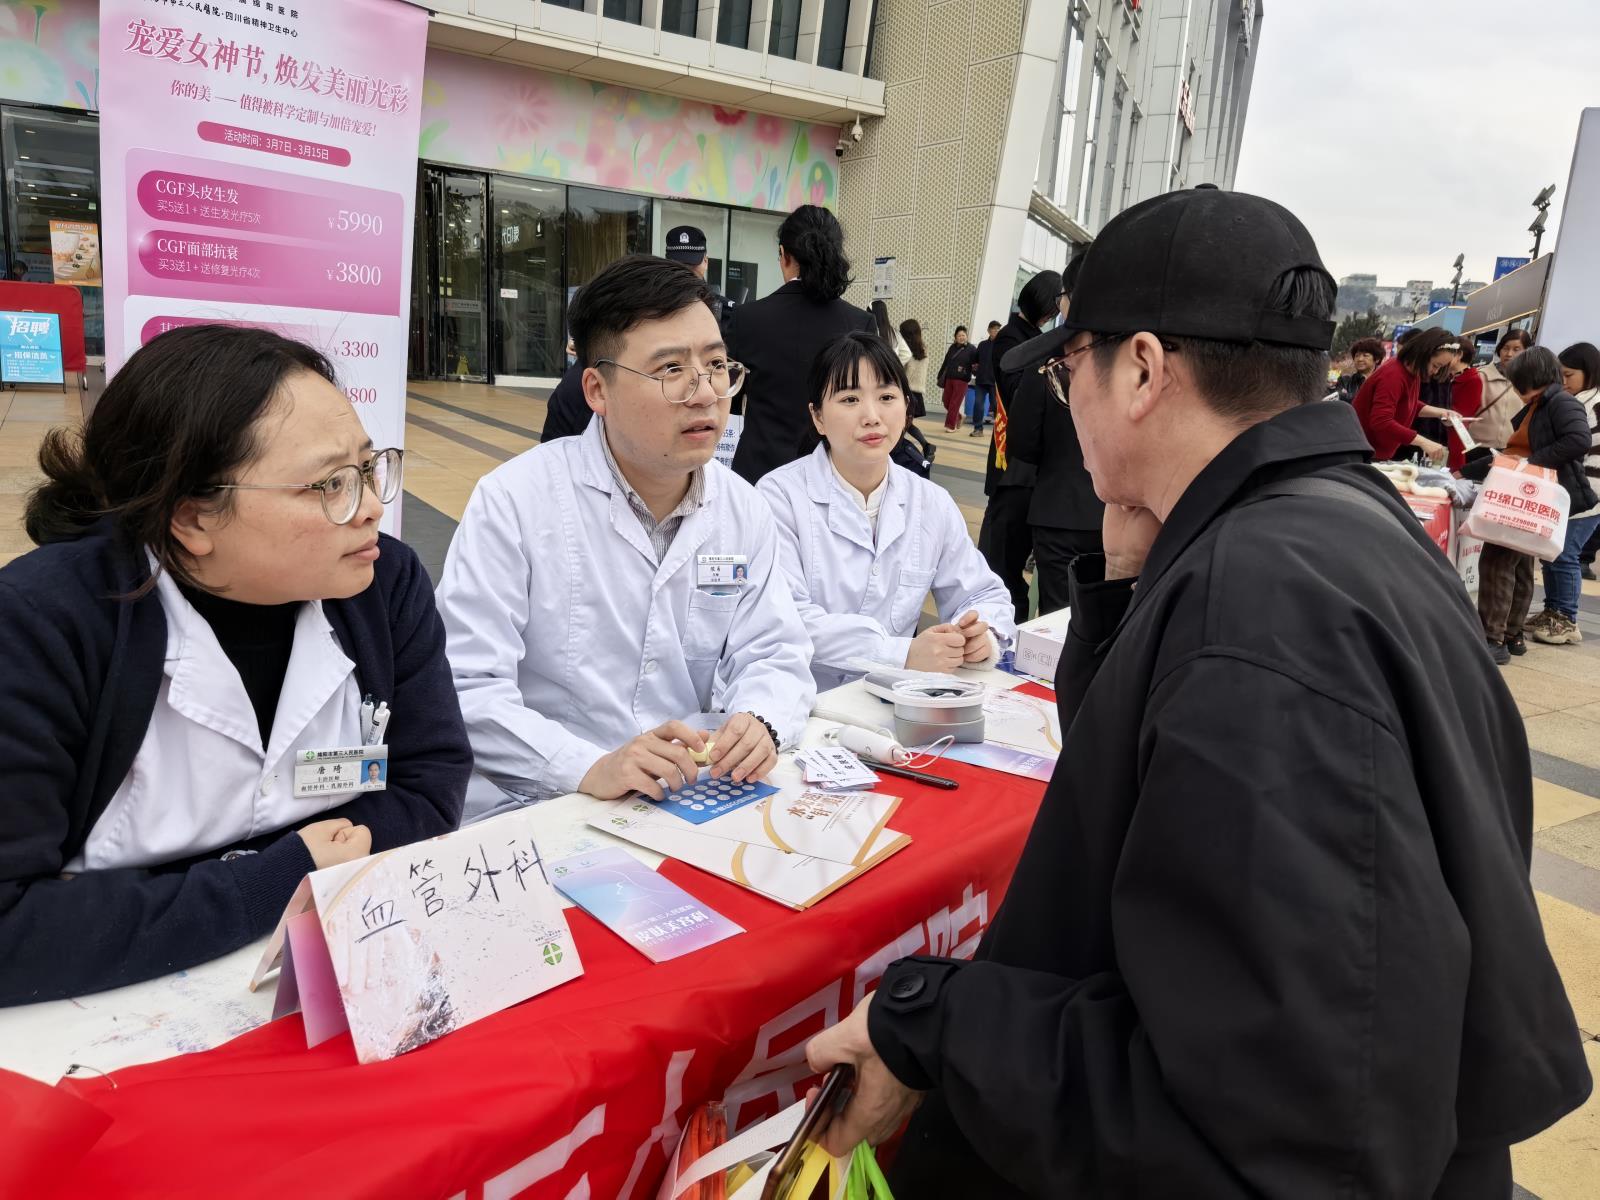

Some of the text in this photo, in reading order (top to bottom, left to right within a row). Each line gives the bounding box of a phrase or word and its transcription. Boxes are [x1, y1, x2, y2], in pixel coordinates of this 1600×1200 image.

[125, 18, 409, 113] 宠爱女神节，焕发美丽光彩
[156, 179, 239, 205] CGF头皮生发
[157, 238, 239, 261] CGF面部抗衰
[1484, 489, 1561, 522] 中绵口腔医院
[355, 838, 549, 943] 血管外科
[635, 910, 710, 942] 皮肤美容科
